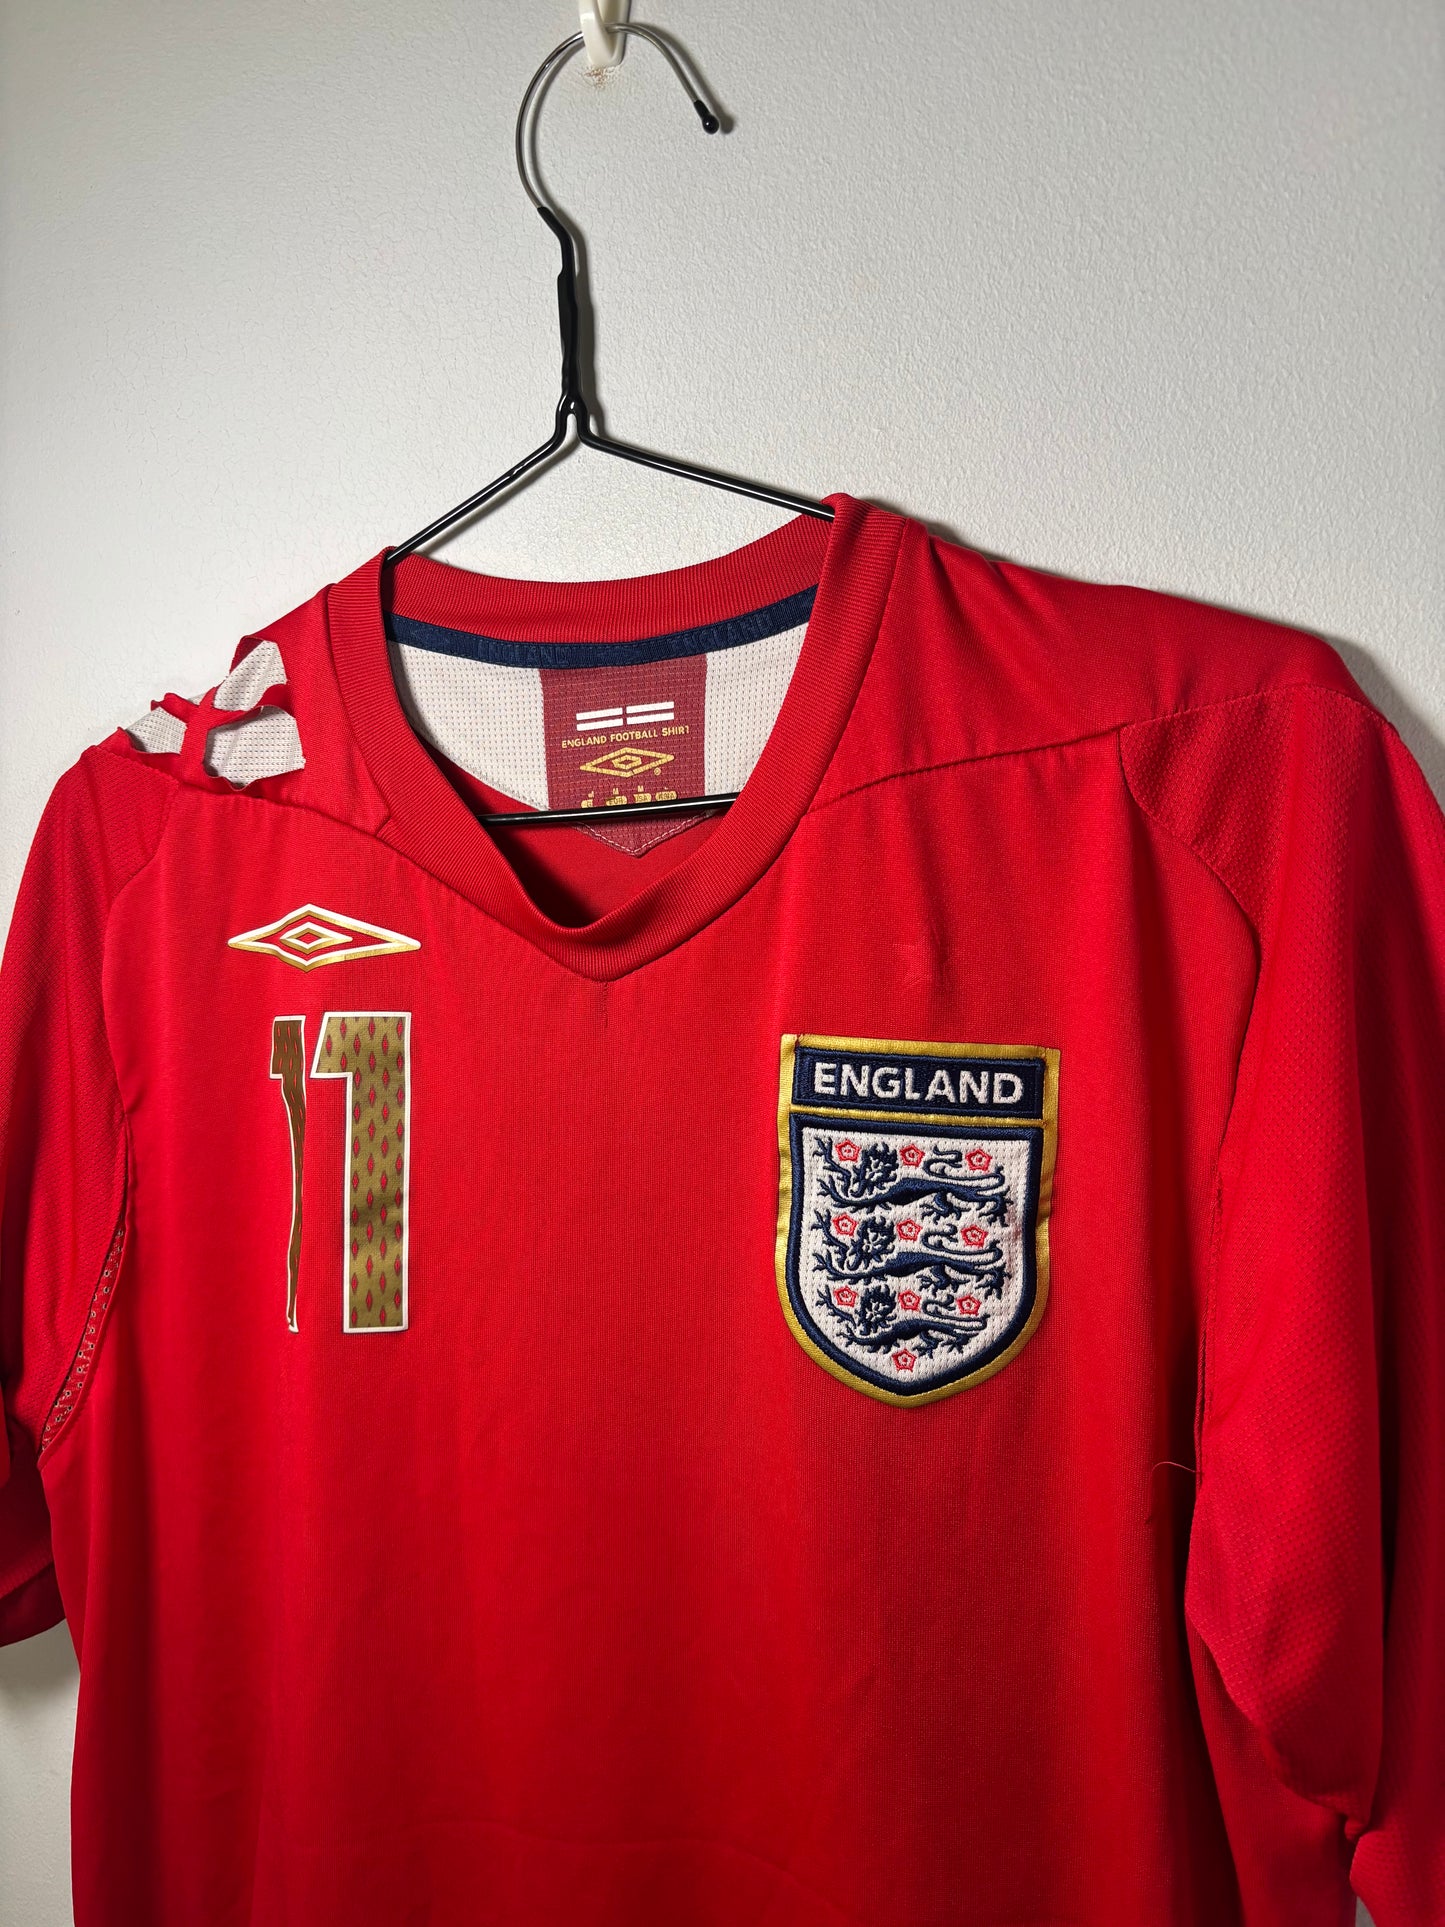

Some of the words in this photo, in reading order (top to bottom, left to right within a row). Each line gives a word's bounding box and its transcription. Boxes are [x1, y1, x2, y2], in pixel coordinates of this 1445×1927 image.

[561, 735, 607, 749] ENGLAND
[610, 728, 659, 742] FOOTBALL
[662, 725, 690, 737] SHIRT
[813, 1061, 1025, 1105] ENGLAND
[270, 1011, 412, 1334] 11
